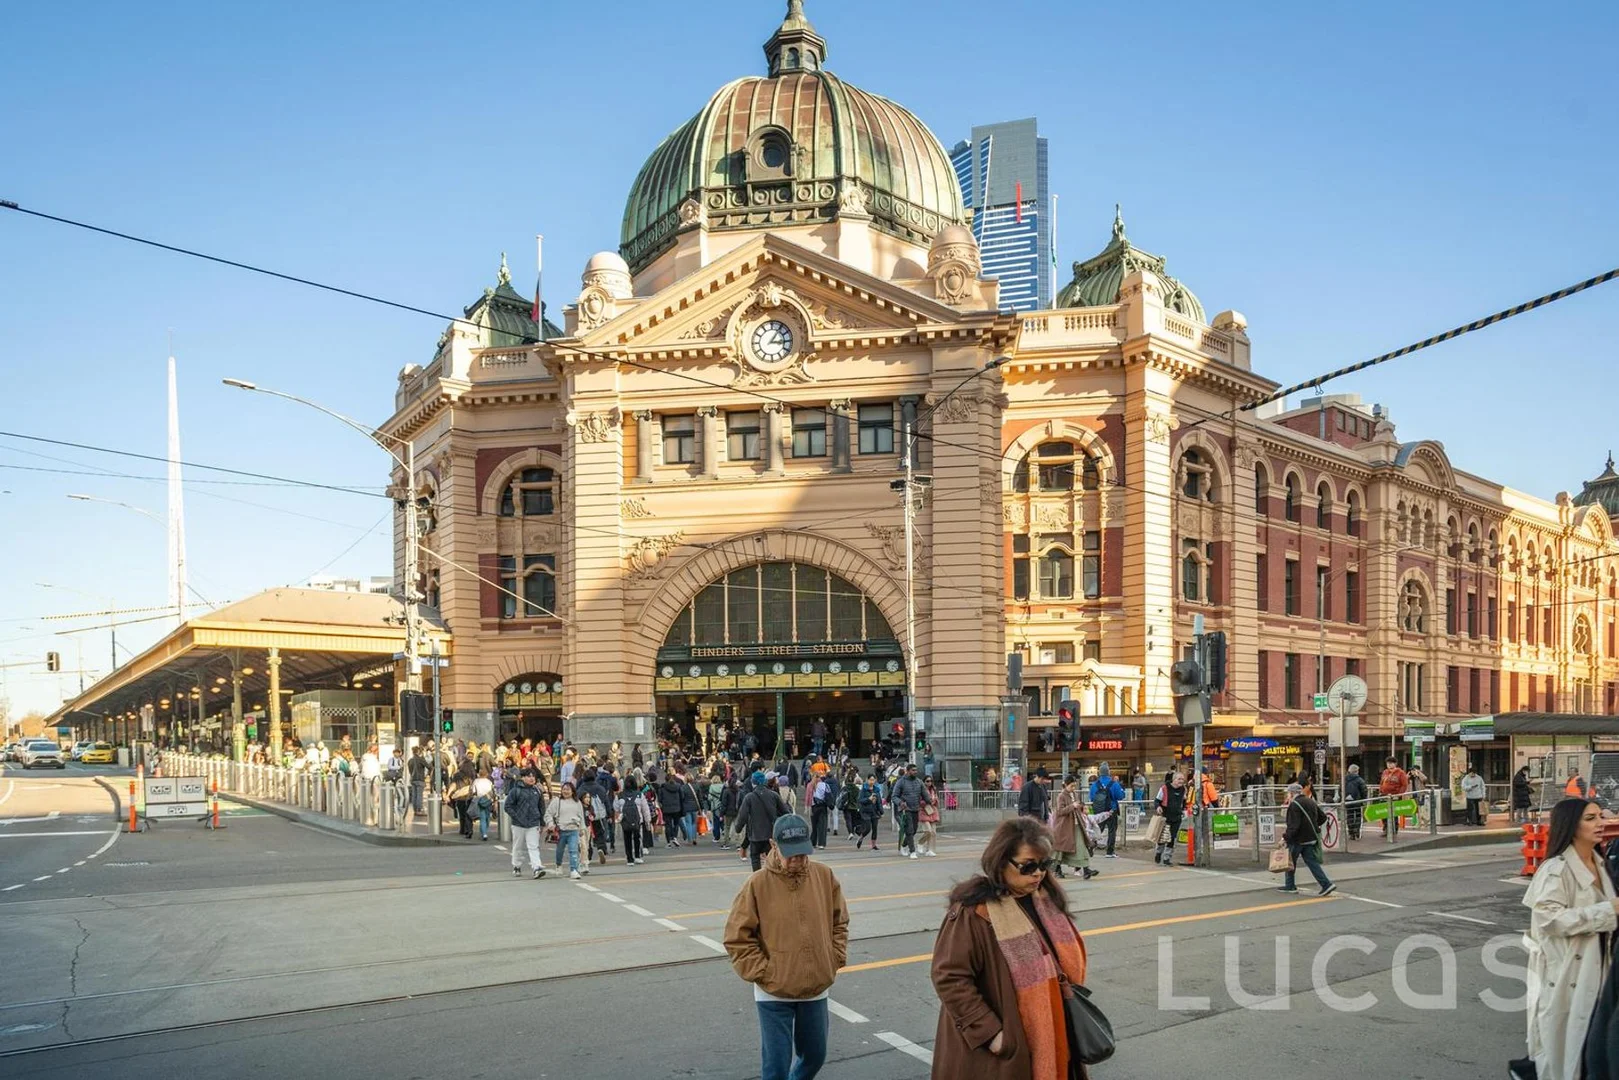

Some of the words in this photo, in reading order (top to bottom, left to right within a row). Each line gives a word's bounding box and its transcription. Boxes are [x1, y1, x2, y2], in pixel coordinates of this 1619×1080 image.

[691, 646, 745, 657] FLINDERS
[758, 645, 800, 655] STREET
[812, 643, 864, 654] STATION
[1089, 741, 1122, 750] HATTERS
[1263, 825, 1271, 833] FOR
